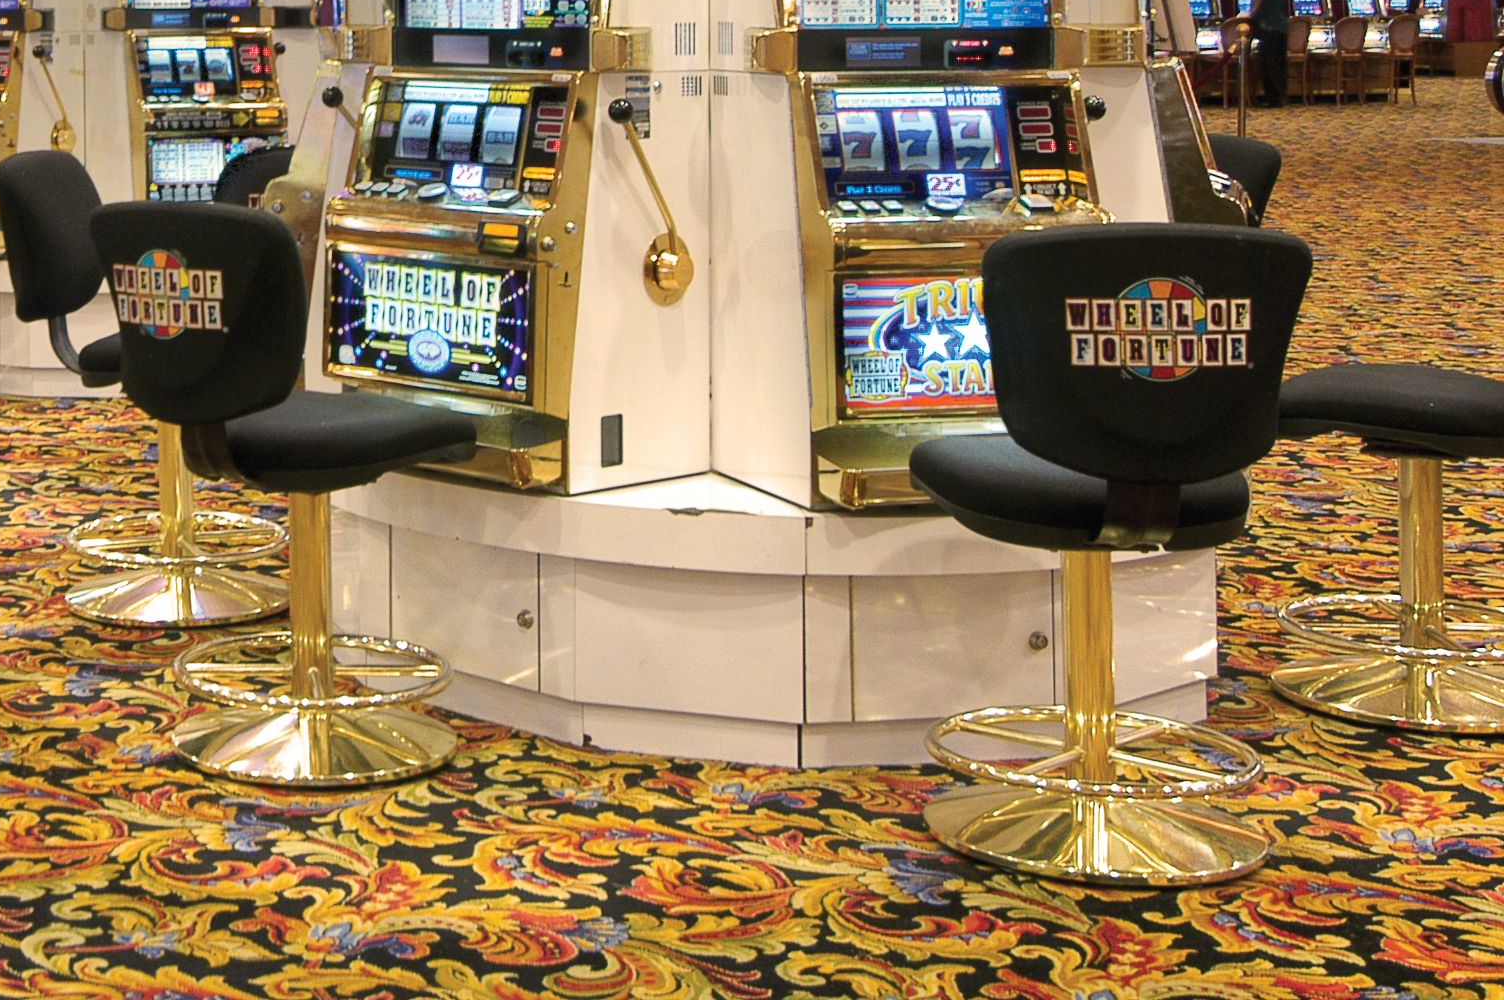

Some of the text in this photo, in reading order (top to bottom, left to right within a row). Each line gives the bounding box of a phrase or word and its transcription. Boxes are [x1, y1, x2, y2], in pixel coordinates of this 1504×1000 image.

[972, 94, 1001, 106] CREDITS
[929, 176, 961, 192] 25¢
[190, 271, 222, 297] OF
[366, 264, 499, 306] WHEEL OF
[119, 296, 221, 328] FORTUNE
[368, 301, 493, 341] FORTUNE
[1066, 300, 1249, 330] WHEEL OF
[1073, 335, 1246, 365] FORTUNE
[852, 358, 900, 374] WHEEL OF
[854, 377, 900, 394] FORTUNE
